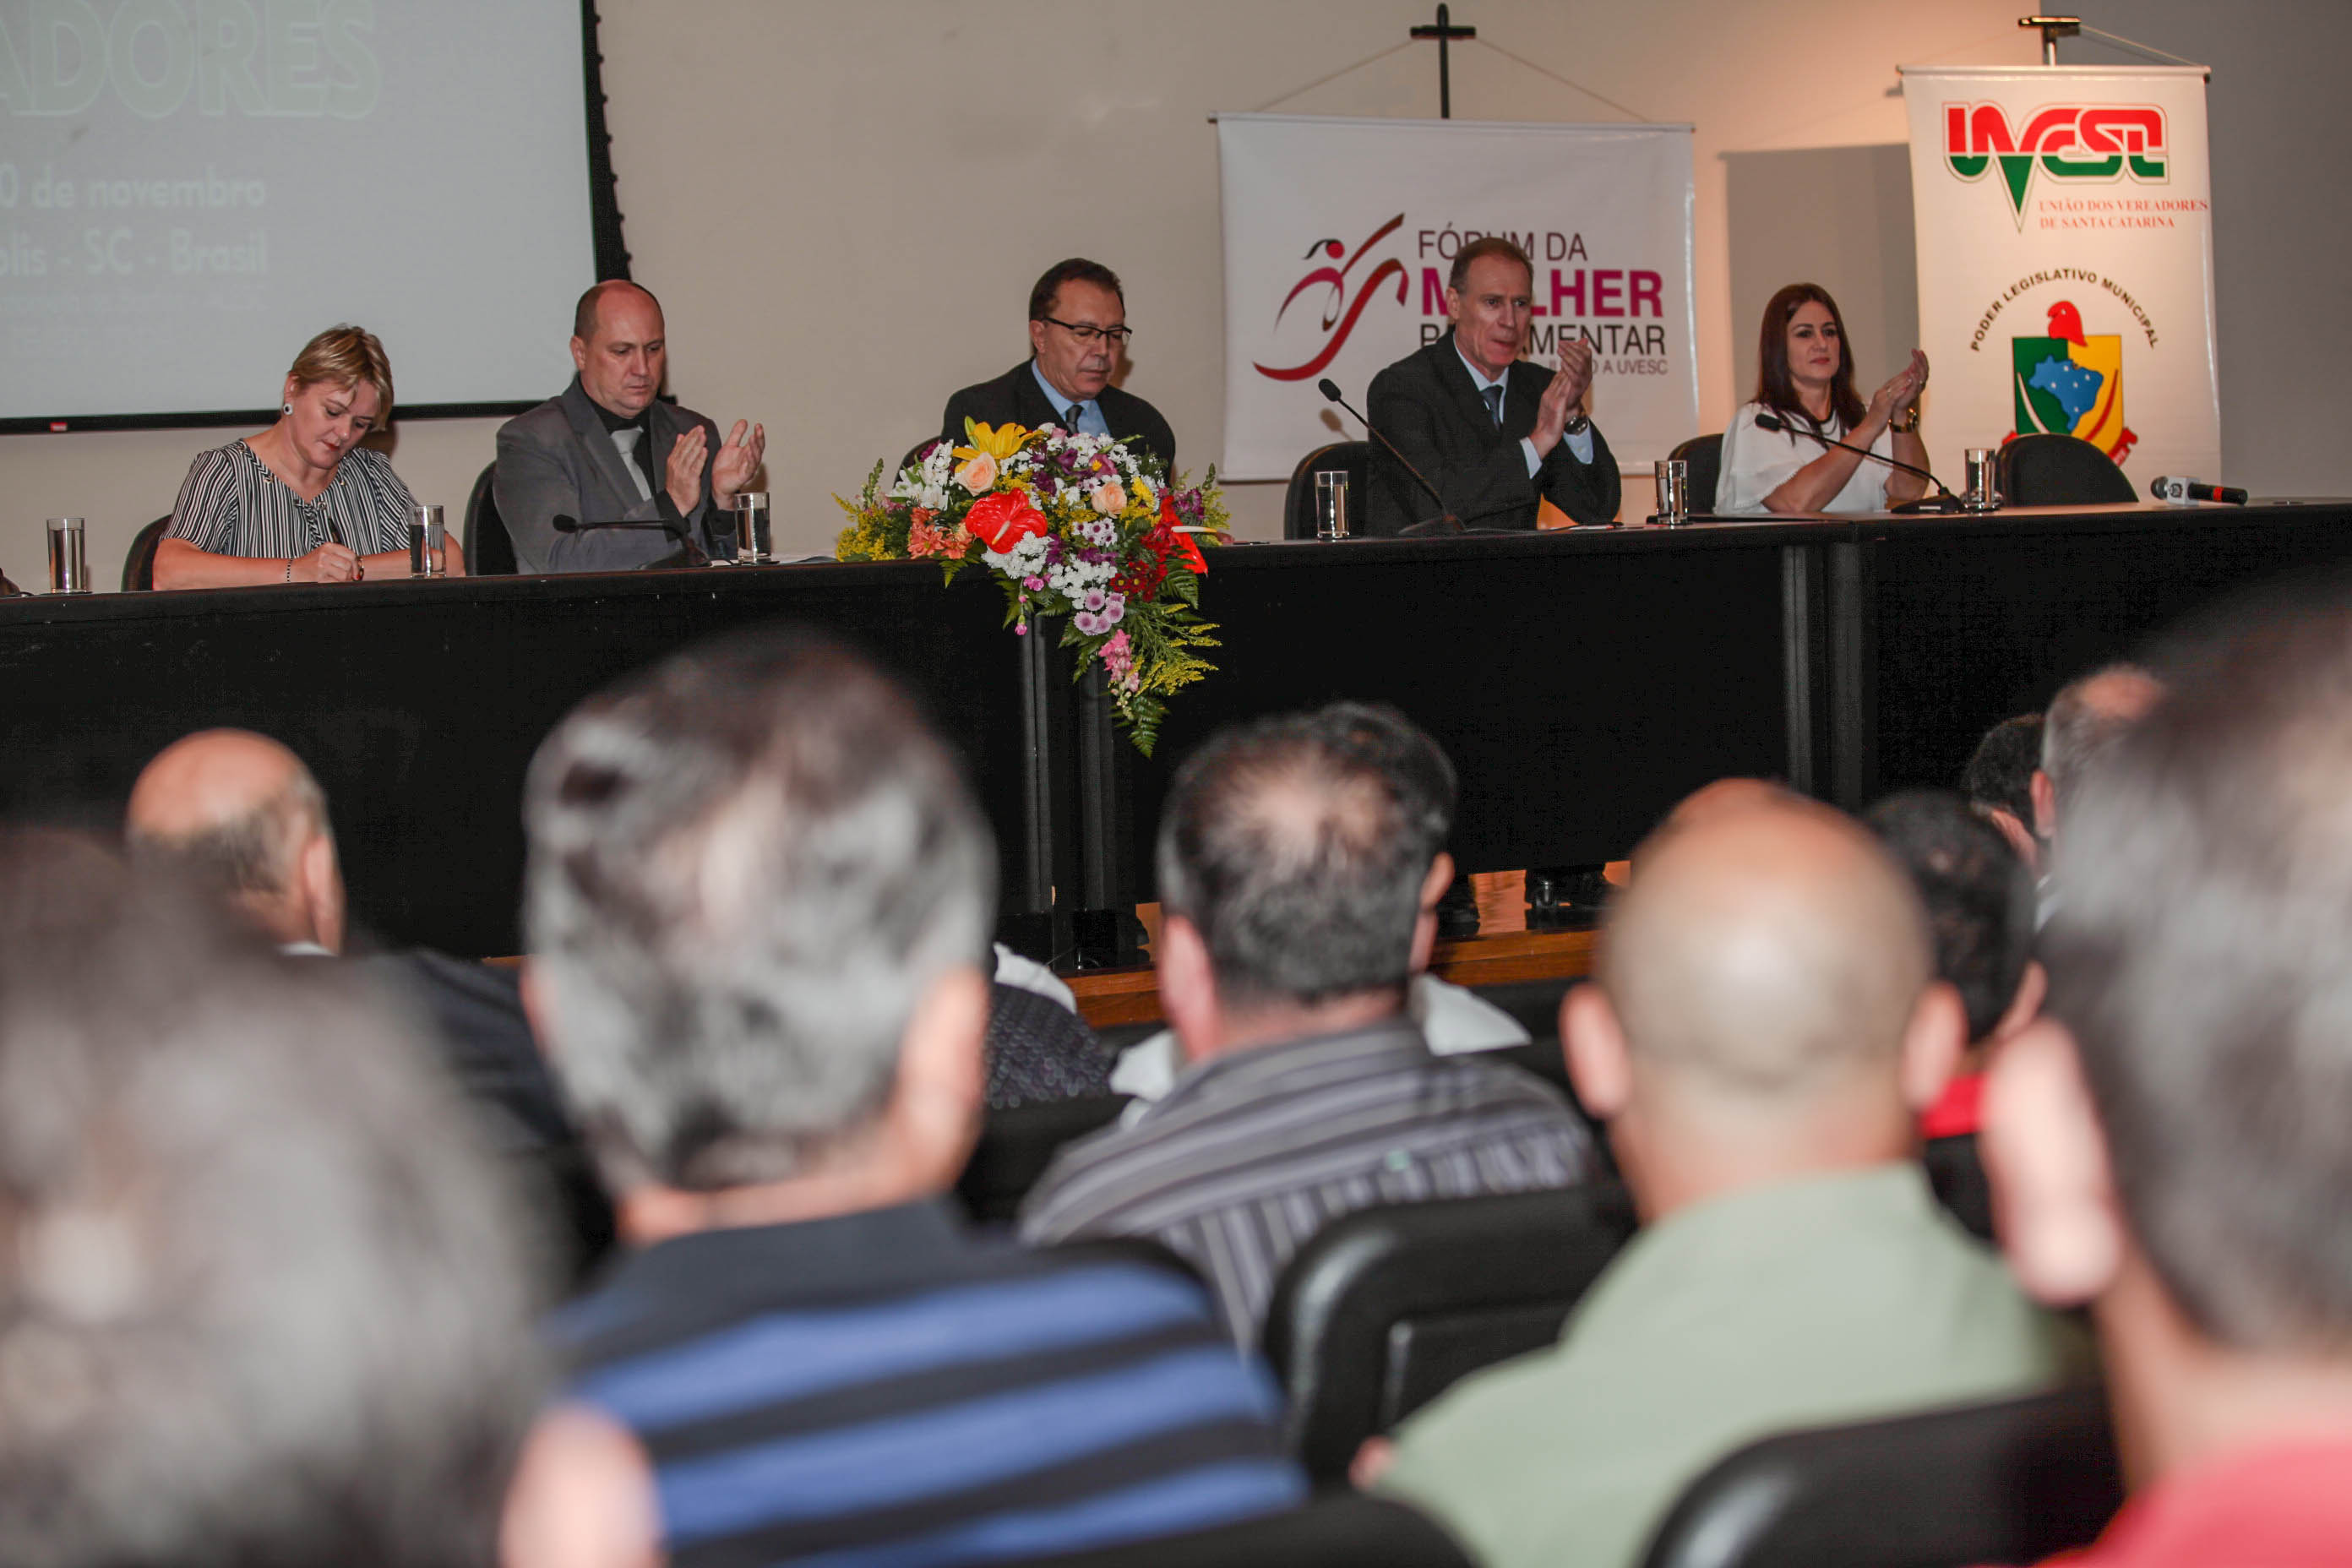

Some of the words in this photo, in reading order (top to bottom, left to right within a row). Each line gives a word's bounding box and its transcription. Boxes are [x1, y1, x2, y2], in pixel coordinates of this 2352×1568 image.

[30, 163, 74, 210] de
[87, 165, 266, 209] novembro
[2039, 197, 2084, 211] UNIÃO
[2088, 199, 2113, 211] DOS
[2115, 198, 2209, 211] VEREADORES
[1418, 220, 1534, 260] FÓM
[1546, 232, 1587, 261] DA
[2039, 216, 2057, 229] DE
[2061, 216, 2106, 229] SANTA
[2108, 216, 2175, 229] CATARINA
[84, 228, 134, 275] SC
[169, 229, 269, 274] Brasil
[1970, 301, 2004, 352] PODER
[2002, 268, 2098, 302] LEGISLATIVO
[2101, 277, 2159, 349] MUNICIPAL
[1603, 359, 1614, 374] A
[1617, 358, 1669, 374] UVESC
